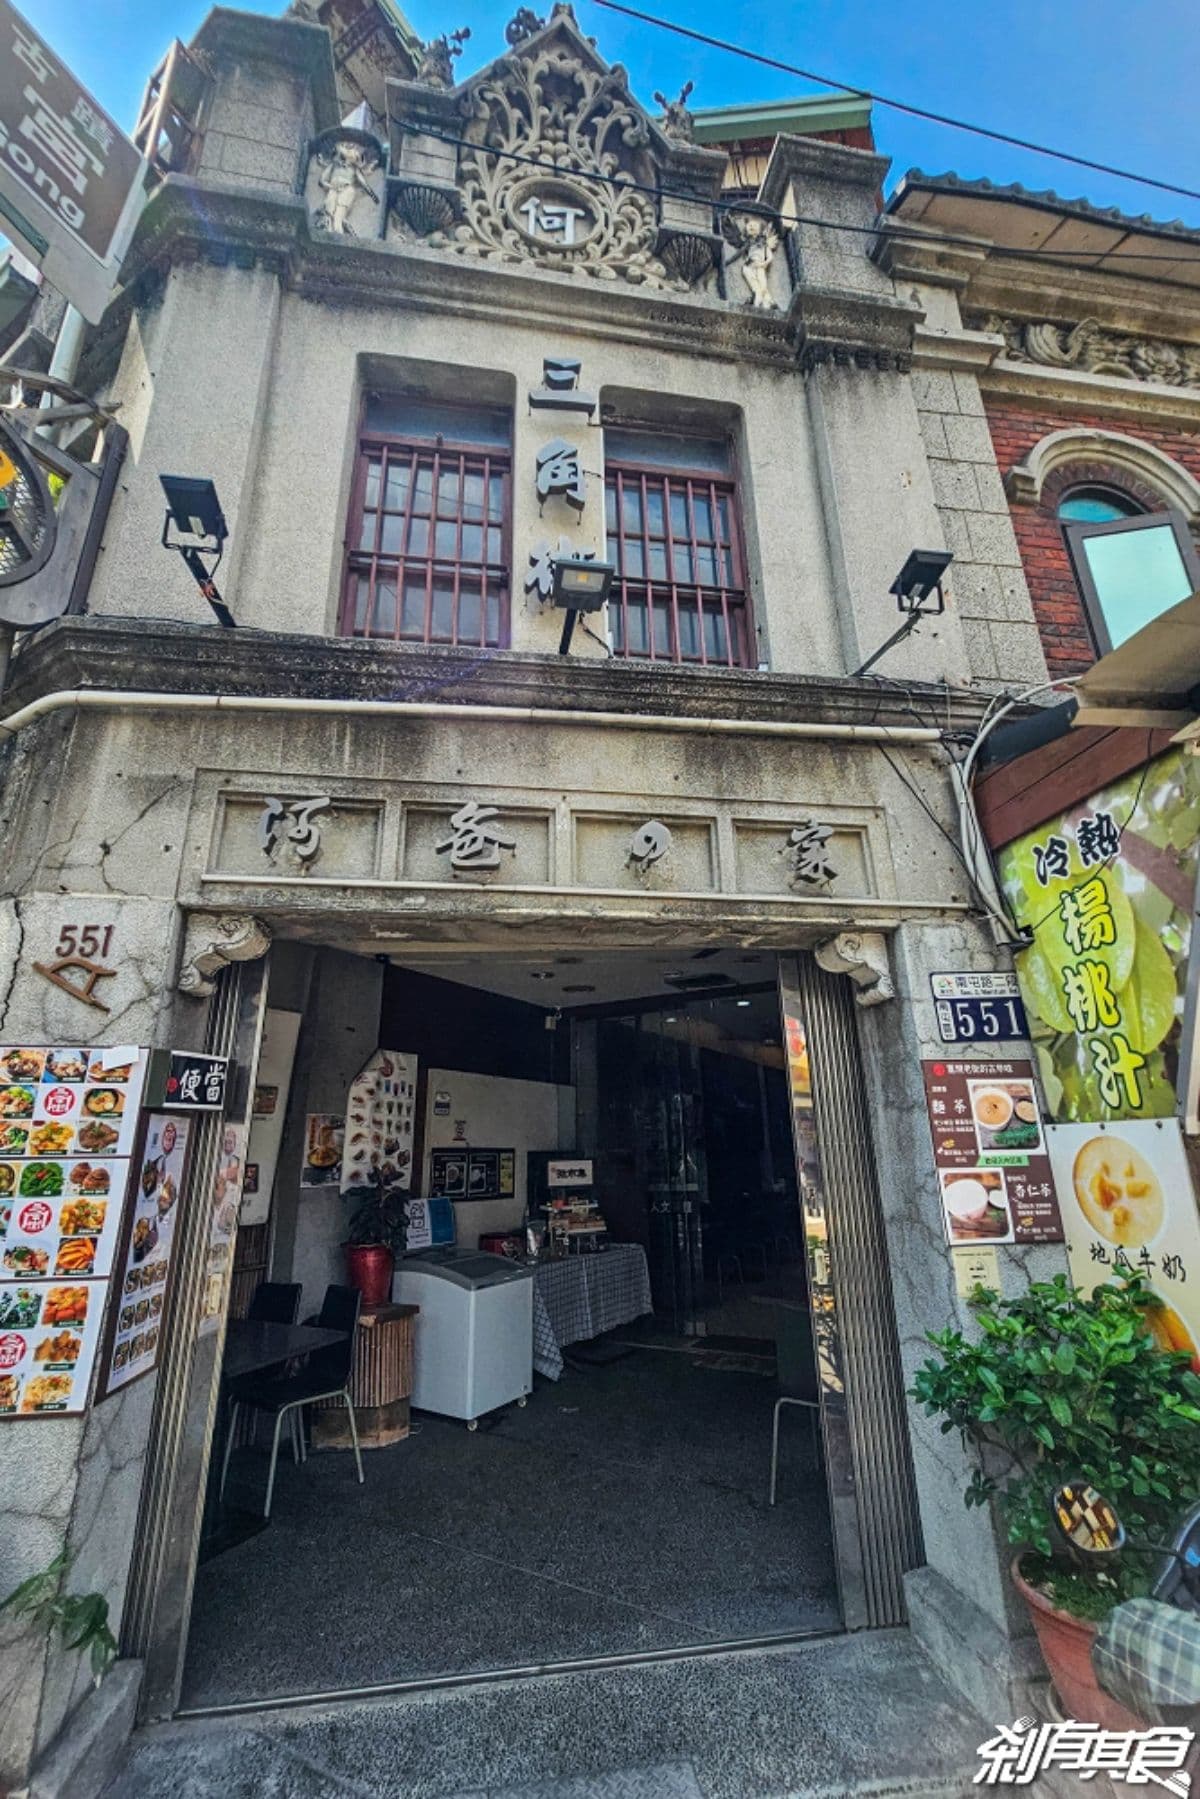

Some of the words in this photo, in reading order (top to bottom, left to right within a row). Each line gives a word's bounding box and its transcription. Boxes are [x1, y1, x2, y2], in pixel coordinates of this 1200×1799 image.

[520, 196, 585, 245] 何
[1033, 812, 1122, 887] 冷熱
[55, 923, 116, 958] 551
[1060, 876, 1146, 1110] 楊桃汁
[956, 1000, 1023, 1037] 551
[179, 1062, 225, 1103] 便當
[1014, 1183, 1052, 1198] 杏仁茶
[1089, 1241, 1187, 1283] 地瓜牛奶
